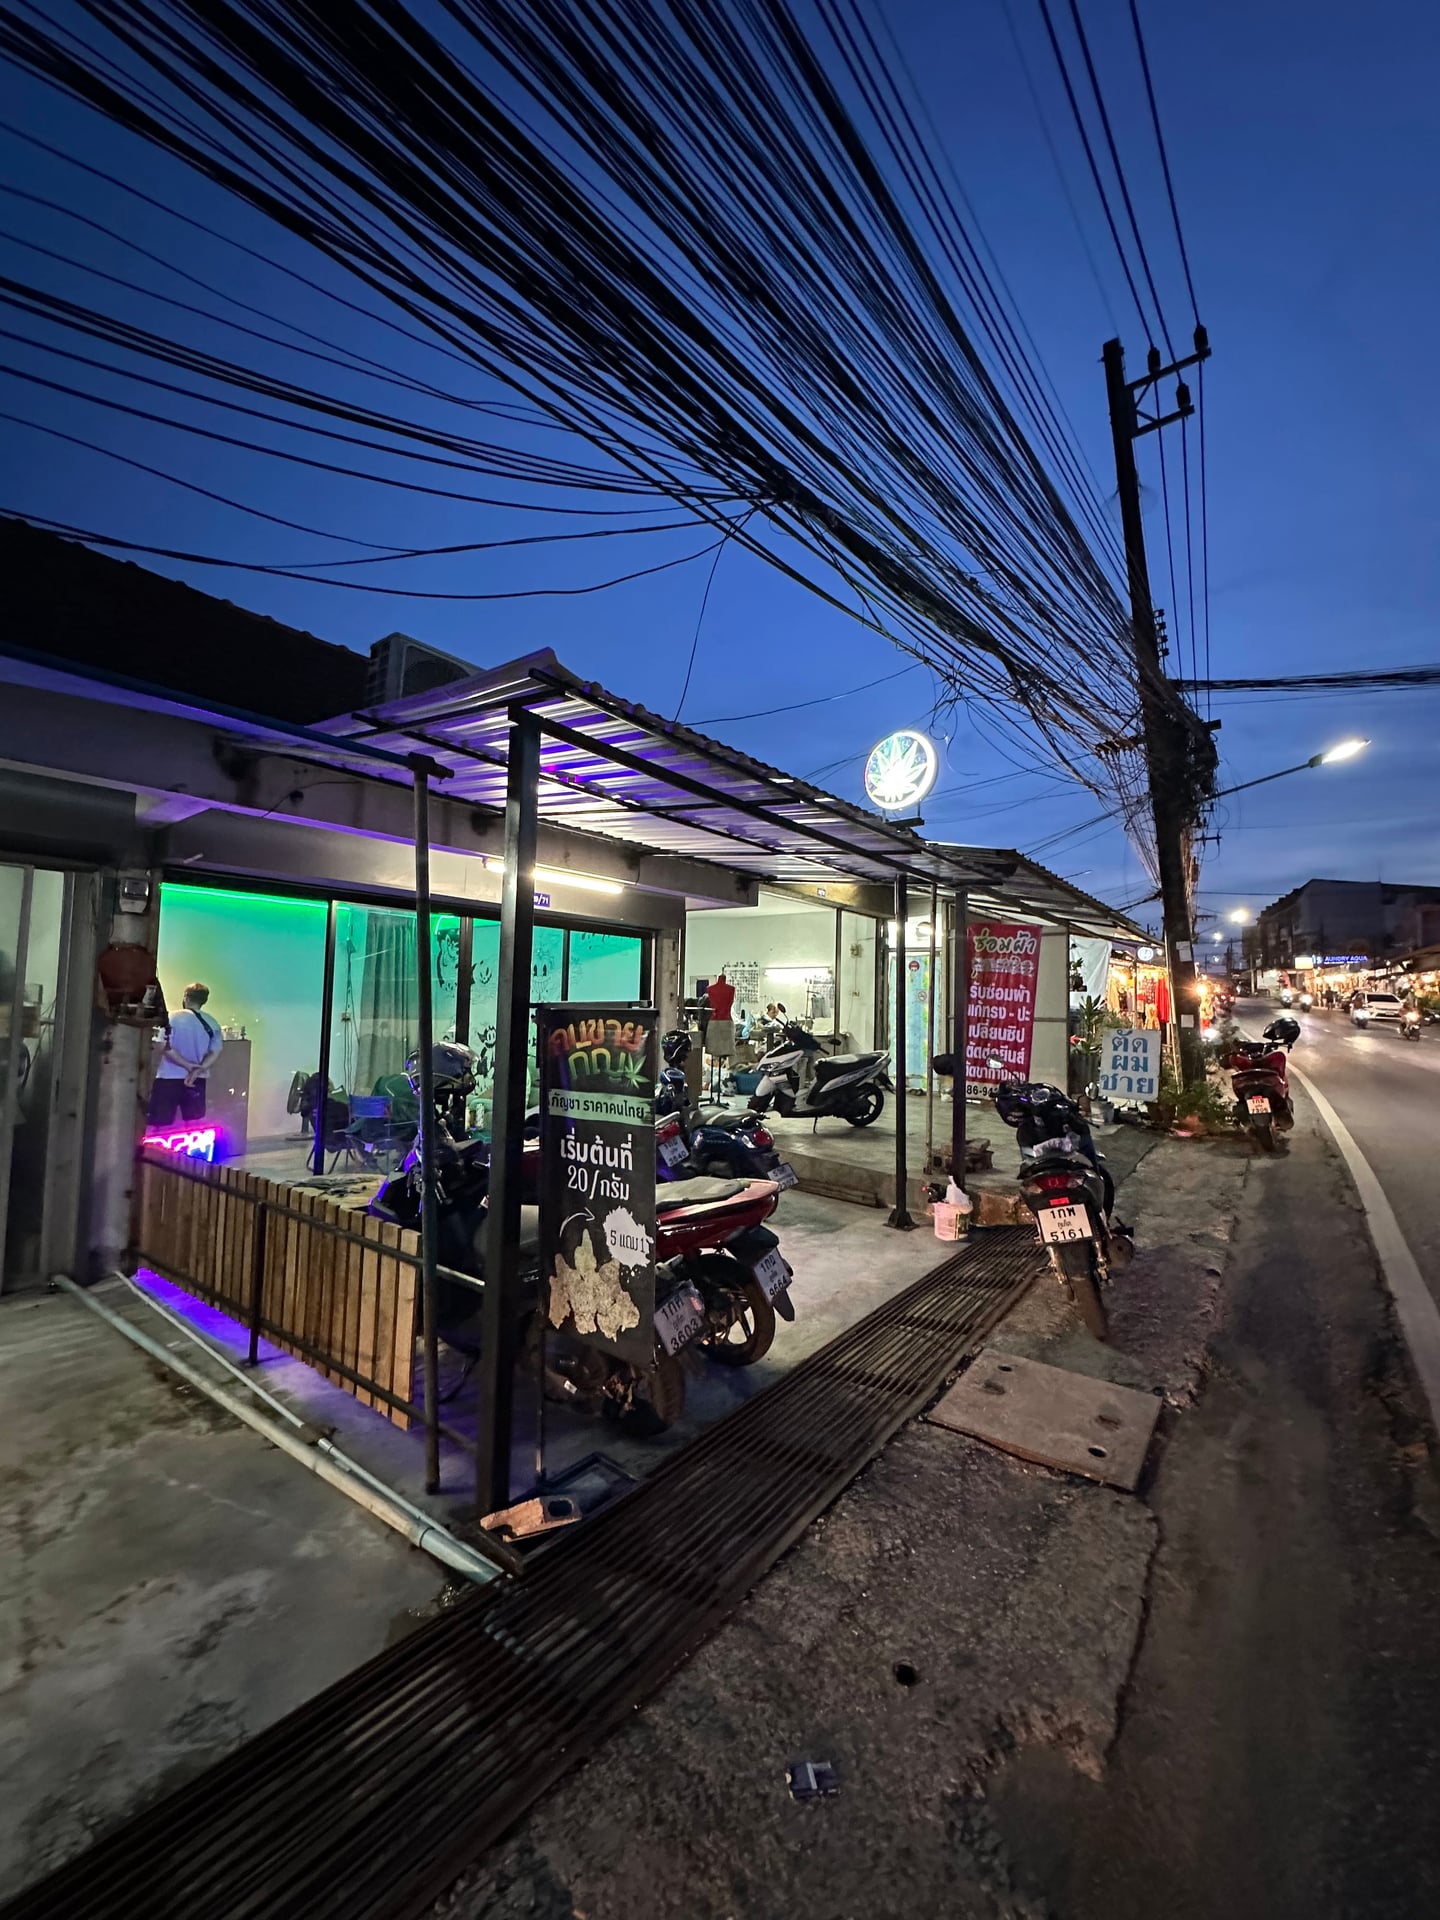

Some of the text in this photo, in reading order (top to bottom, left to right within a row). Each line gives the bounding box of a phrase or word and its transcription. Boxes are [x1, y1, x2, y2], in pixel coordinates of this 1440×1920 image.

[970, 981, 1031, 1003] รับซ่อมผ้า
[967, 1001, 1006, 1019] แก้ทรง
[1017, 1006, 1031, 1022] ปะ
[968, 1019, 1025, 1043] เปลี่ยนซิป
[1112, 1029, 1148, 1053] ตัด
[1111, 1055, 1148, 1072] ผม
[1101, 1073, 1153, 1094] ชาย
[551, 1092, 644, 1119] กัญชา ราคาคนไทย
[560, 1127, 633, 1171] เริ่มต้นที่
[567, 1165, 630, 1200] 20/กรัม
[1050, 1206, 1076, 1219] 1กพ
[610, 1230, 646, 1254] 5 แถม 1
[1050, 1228, 1085, 1241] 5161
[769, 1275, 787, 1297] 9664
[670, 1318, 698, 1351] 3603
